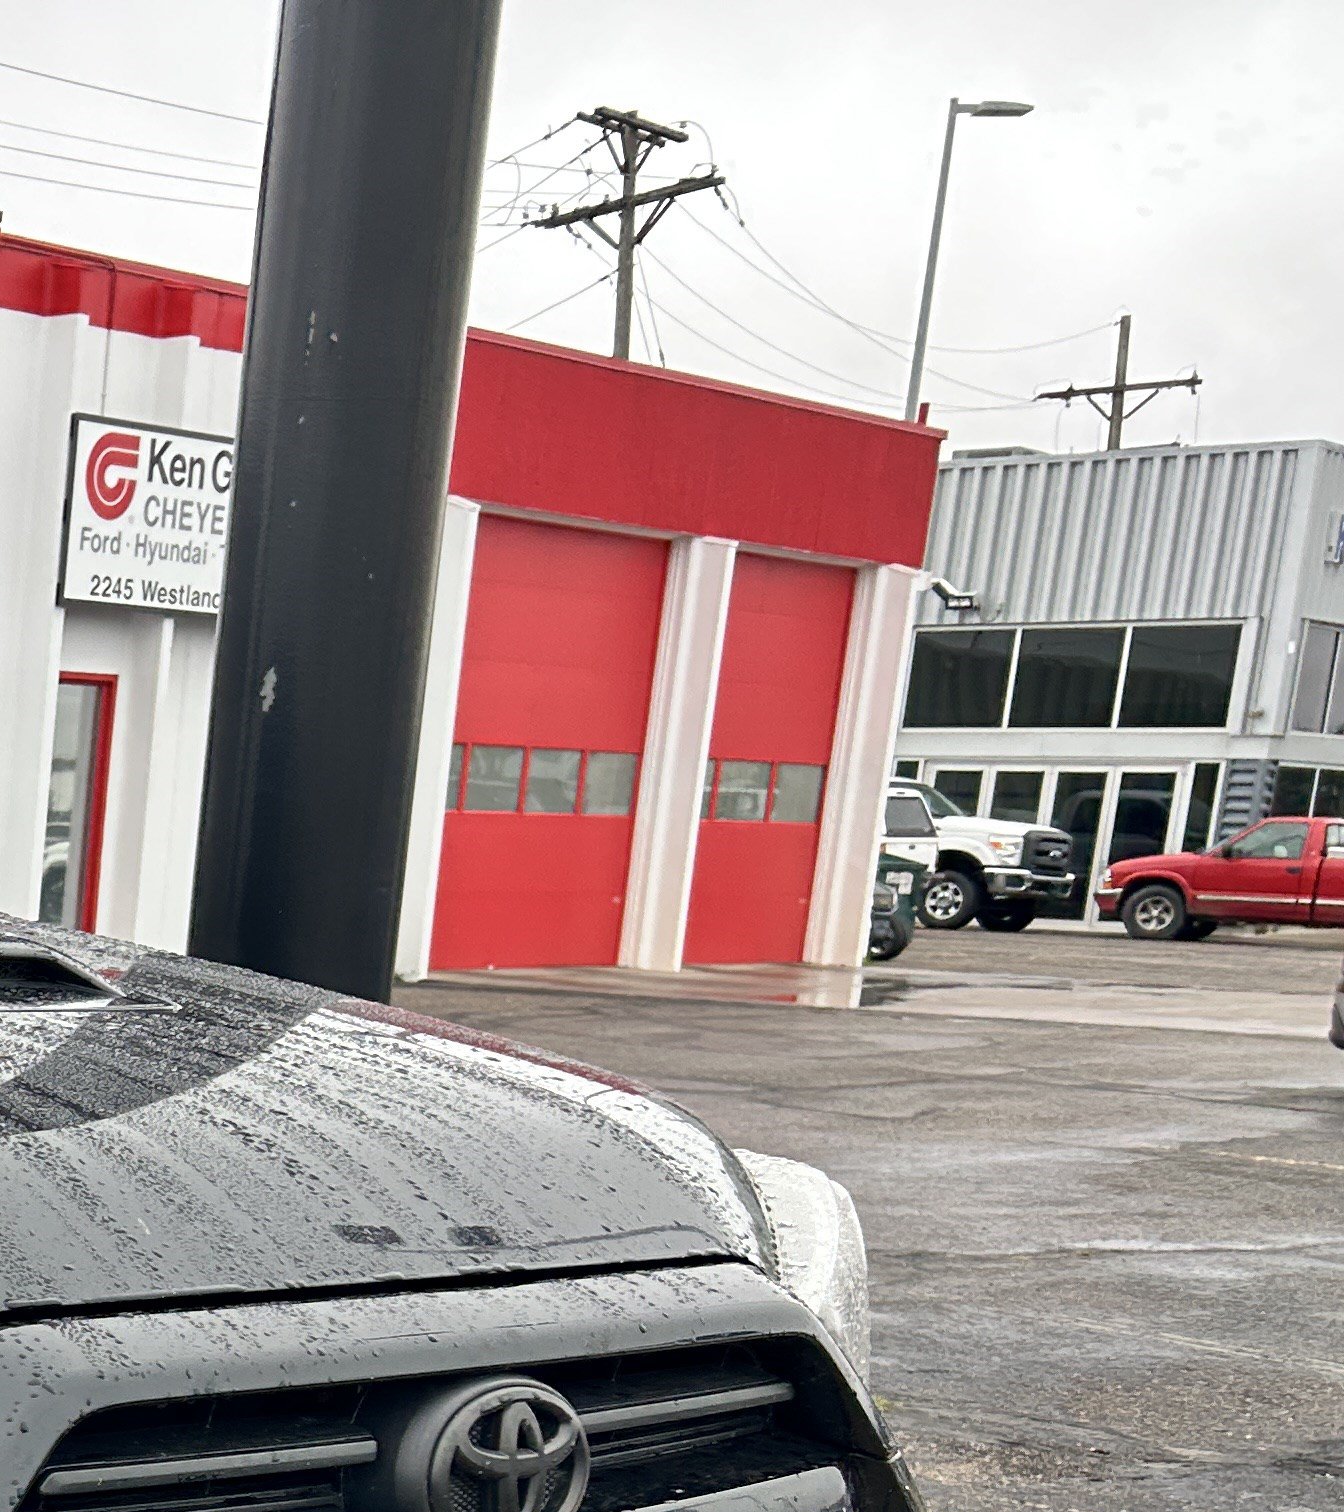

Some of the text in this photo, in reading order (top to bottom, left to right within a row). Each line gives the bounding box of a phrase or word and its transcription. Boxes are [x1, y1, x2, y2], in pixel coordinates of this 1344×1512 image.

[148, 438, 205, 490] Ken
[79, 526, 208, 566] Ford Hyundai
[90, 575, 134, 600] 2245
